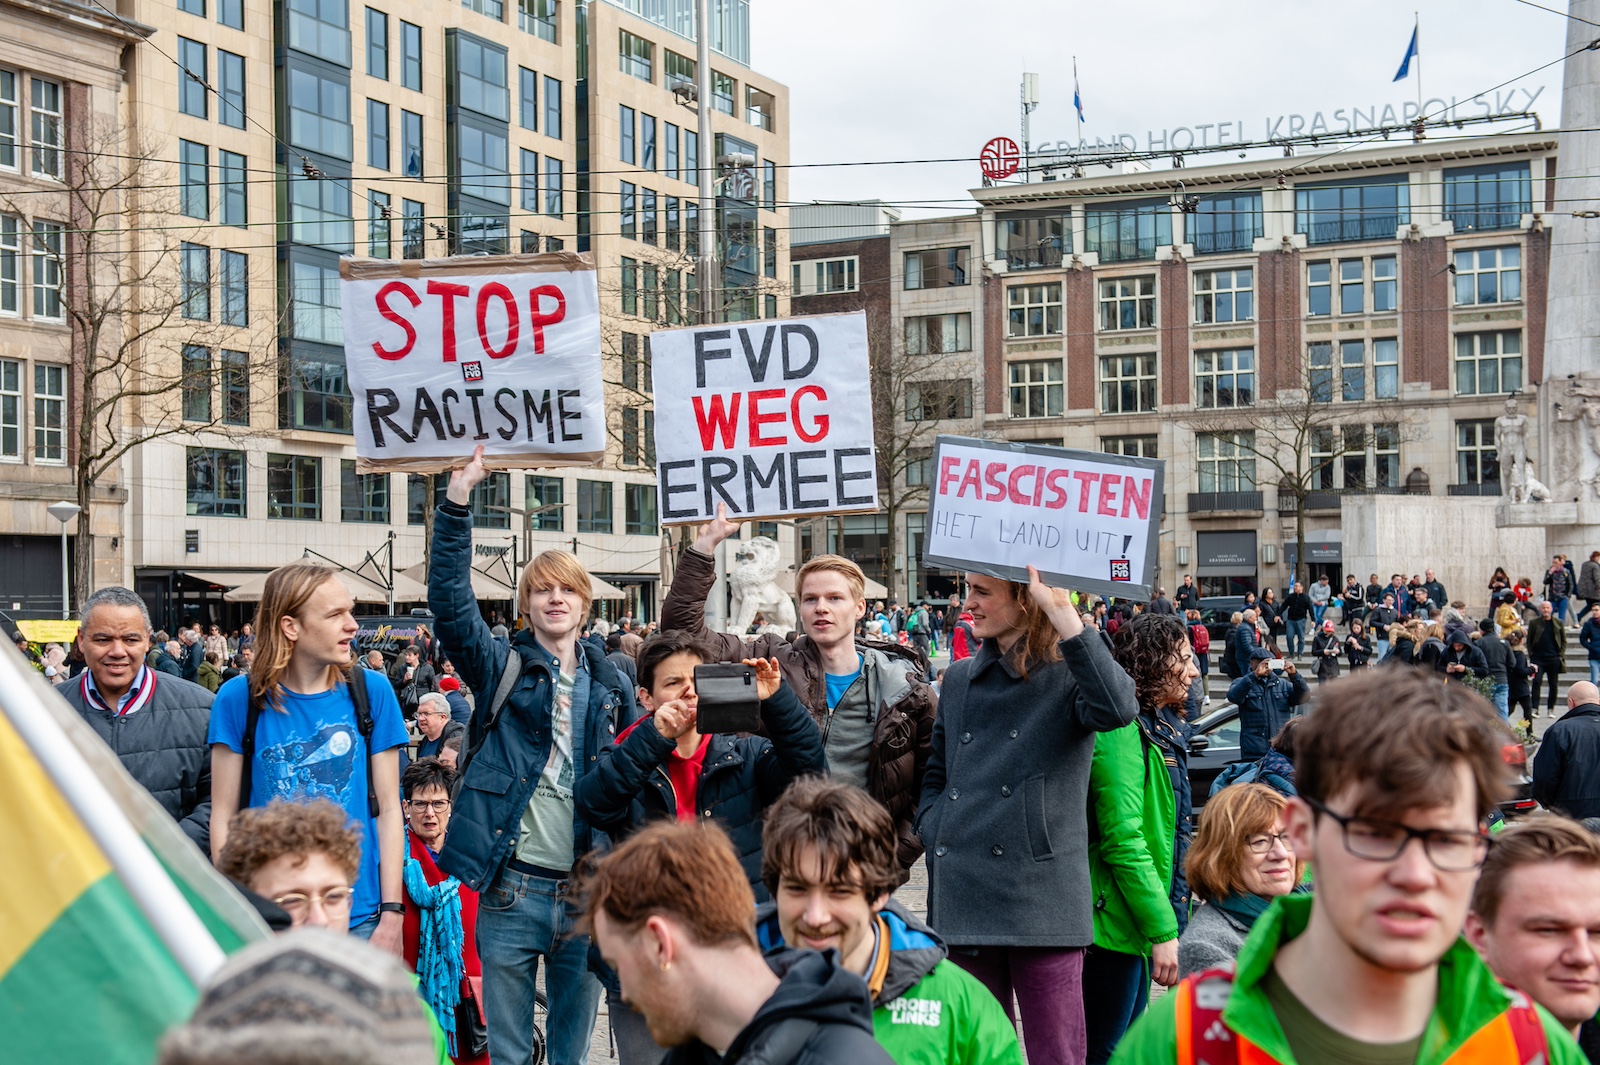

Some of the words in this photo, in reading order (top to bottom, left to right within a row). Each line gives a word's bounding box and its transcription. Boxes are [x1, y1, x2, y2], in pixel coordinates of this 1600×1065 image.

[1035, 133, 1137, 166] GRAND
[1147, 120, 1253, 153] HOTEL
[1265, 86, 1546, 142] KRASNAPOLSKY
[371, 280, 566, 363] STOP
[463, 363, 480, 371] FCK
[465, 369, 481, 378] FVD
[694, 324, 819, 388] FVD
[365, 386, 583, 448] RACISME
[691, 385, 830, 452] WEG
[660, 447, 874, 519] ERMEE
[939, 456, 1152, 520] FASCISTEN
[935, 510, 982, 540] HET
[999, 518, 1061, 549] LAND
[1075, 528, 1133, 559] UIT!
[1112, 562, 1128, 570] FCK
[1112, 570, 1129, 578] FVD
[891, 1010, 941, 1027] LINKS
